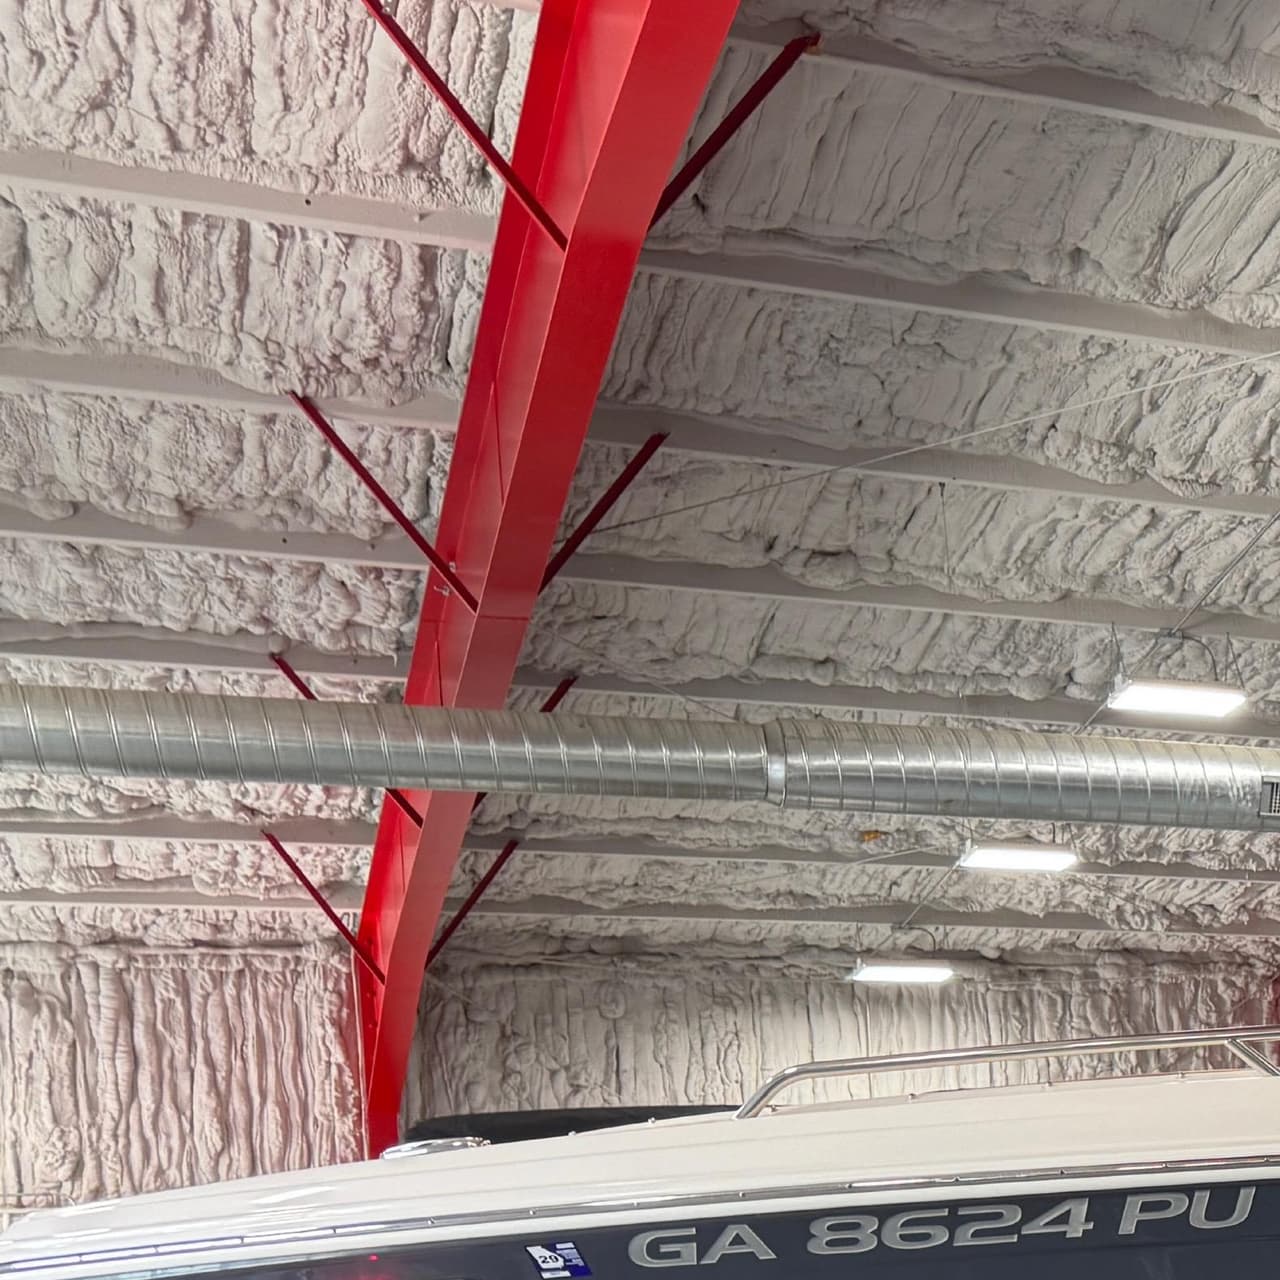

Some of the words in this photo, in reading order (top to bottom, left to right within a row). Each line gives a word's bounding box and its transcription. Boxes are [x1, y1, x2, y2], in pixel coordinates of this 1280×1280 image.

[627, 1223, 777, 1269] GA
[806, 1198, 1095, 1256] 8624
[1118, 1184, 1257, 1236] PU
